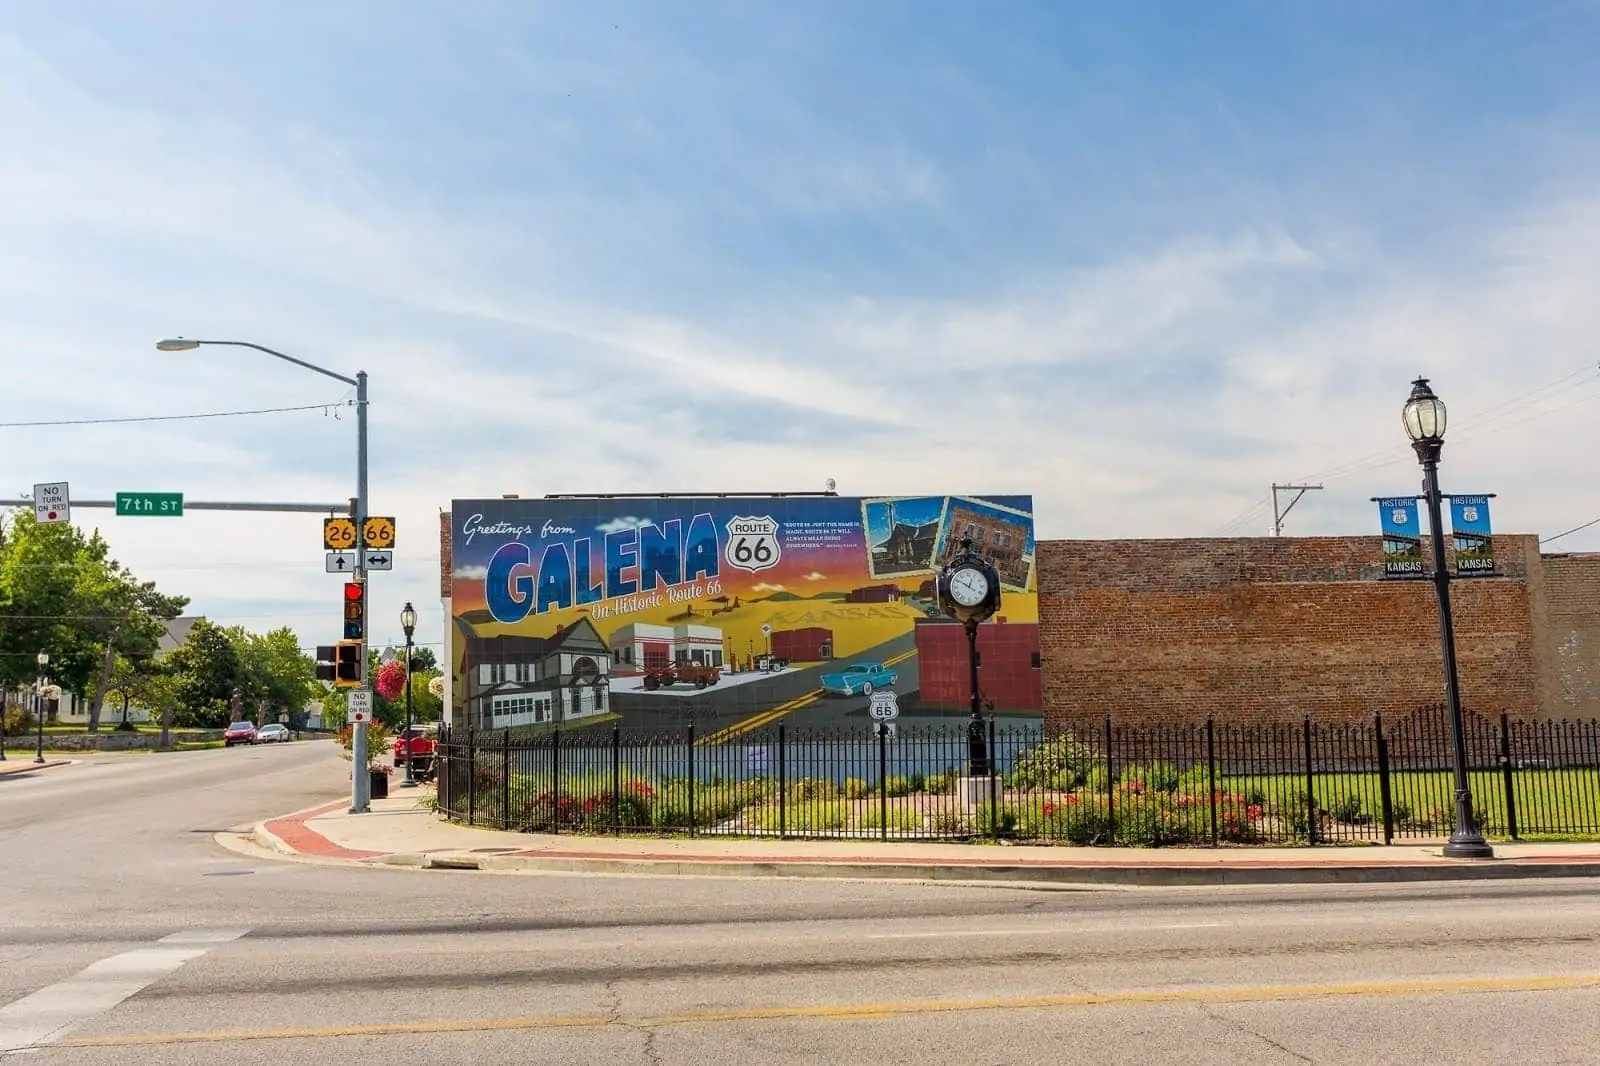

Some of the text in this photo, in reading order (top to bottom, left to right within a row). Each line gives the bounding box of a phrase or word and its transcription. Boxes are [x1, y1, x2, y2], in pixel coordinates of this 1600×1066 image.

[43, 486, 59, 495] NO
[42, 495, 62, 503] TURN
[121, 498, 178, 511] 7th ST
[1381, 499, 1415, 507] HISTORIC
[1452, 496, 1486, 505] HISTORIC
[38, 503, 66, 512] ON RED
[329, 526, 352, 541] 26
[366, 524, 390, 540] 66
[463, 513, 576, 545] Greetings from
[735, 523, 770, 533] ROUTE
[735, 537, 772, 562] 66
[484, 513, 720, 624] GALENA
[1387, 561, 1422, 571] KANSAS
[1458, 558, 1493, 569] KANSAS
[592, 581, 722, 620] On Historic Route 66
[769, 605, 910, 626] KANSAS
[876, 707, 891, 716] 66
